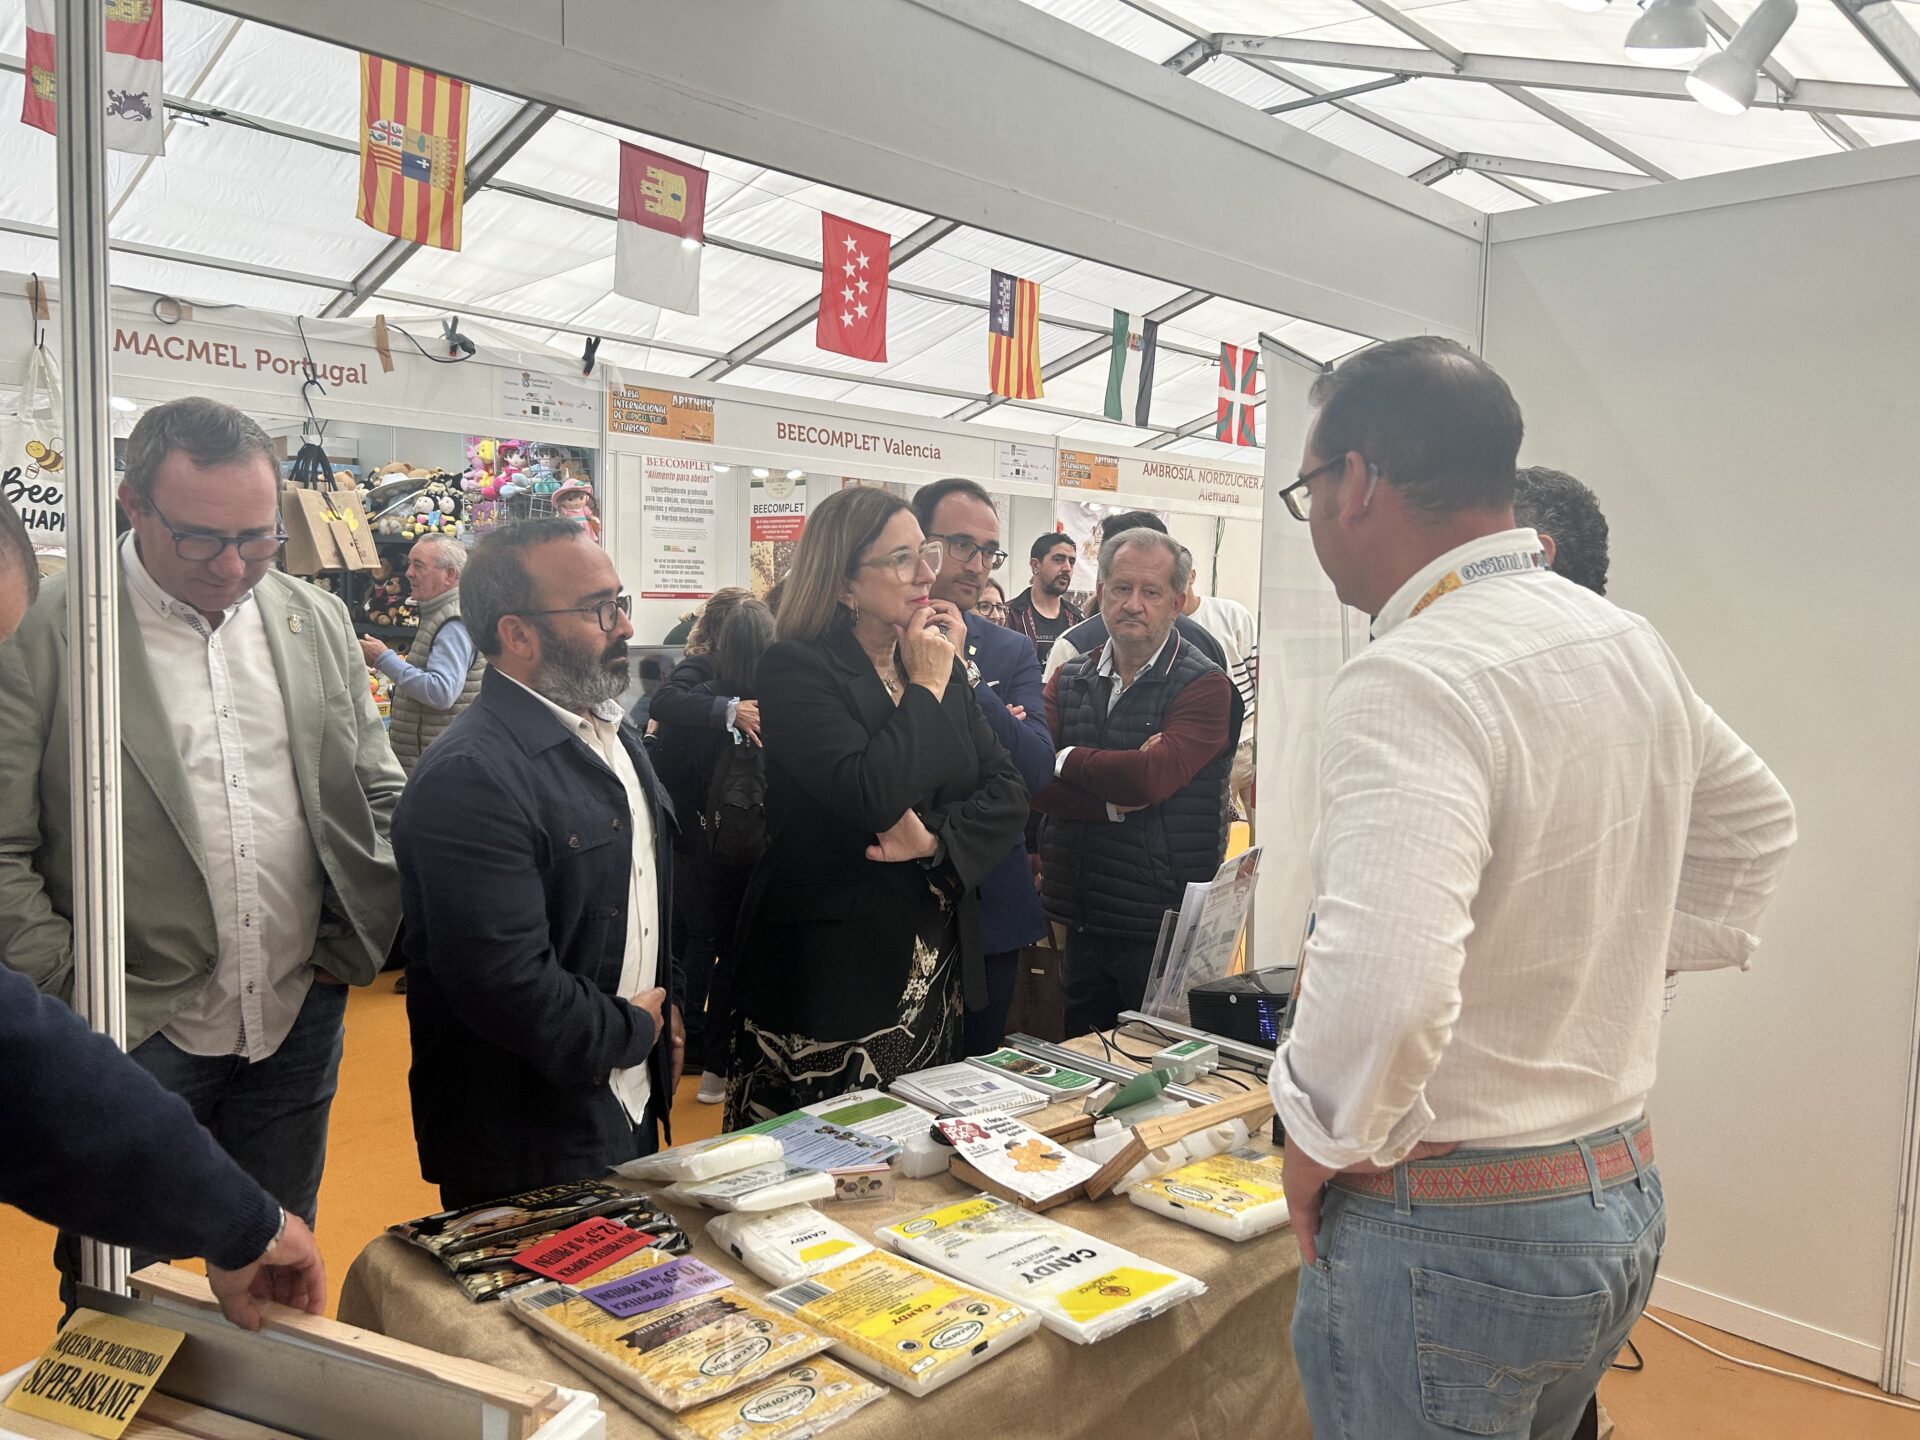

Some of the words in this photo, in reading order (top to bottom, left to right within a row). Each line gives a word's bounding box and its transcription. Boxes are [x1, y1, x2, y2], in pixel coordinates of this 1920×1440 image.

[113, 328, 246, 369] MACMEL
[254, 348, 368, 387] Portugal
[613, 399, 667, 414] INTERNACIONAL
[613, 410, 623, 420] DE
[620, 422, 650, 434] TURISMO
[776, 422, 880, 452] BEECOMPLET
[883, 437, 941, 460] Valencia
[646, 456, 712, 471] BEECOMPLET
[1, 466, 64, 504] Bee
[676, 473, 690, 483] para
[1198, 470, 1259, 489] NORDZUCKER
[1198, 488, 1240, 504] Alemania
[753, 502, 805, 514] BEECOMPLET
[579, 1220, 625, 1247] 12,5%
[790, 1230, 827, 1245] CANDY
[1020, 1248, 1098, 1284] CANDY
[891, 1303, 932, 1326] CANDY
[634, 1313, 680, 1336] PROTEIN
[89, 1340, 106, 1363] DE
[99, 1343, 164, 1377] POLIESTIRENO
